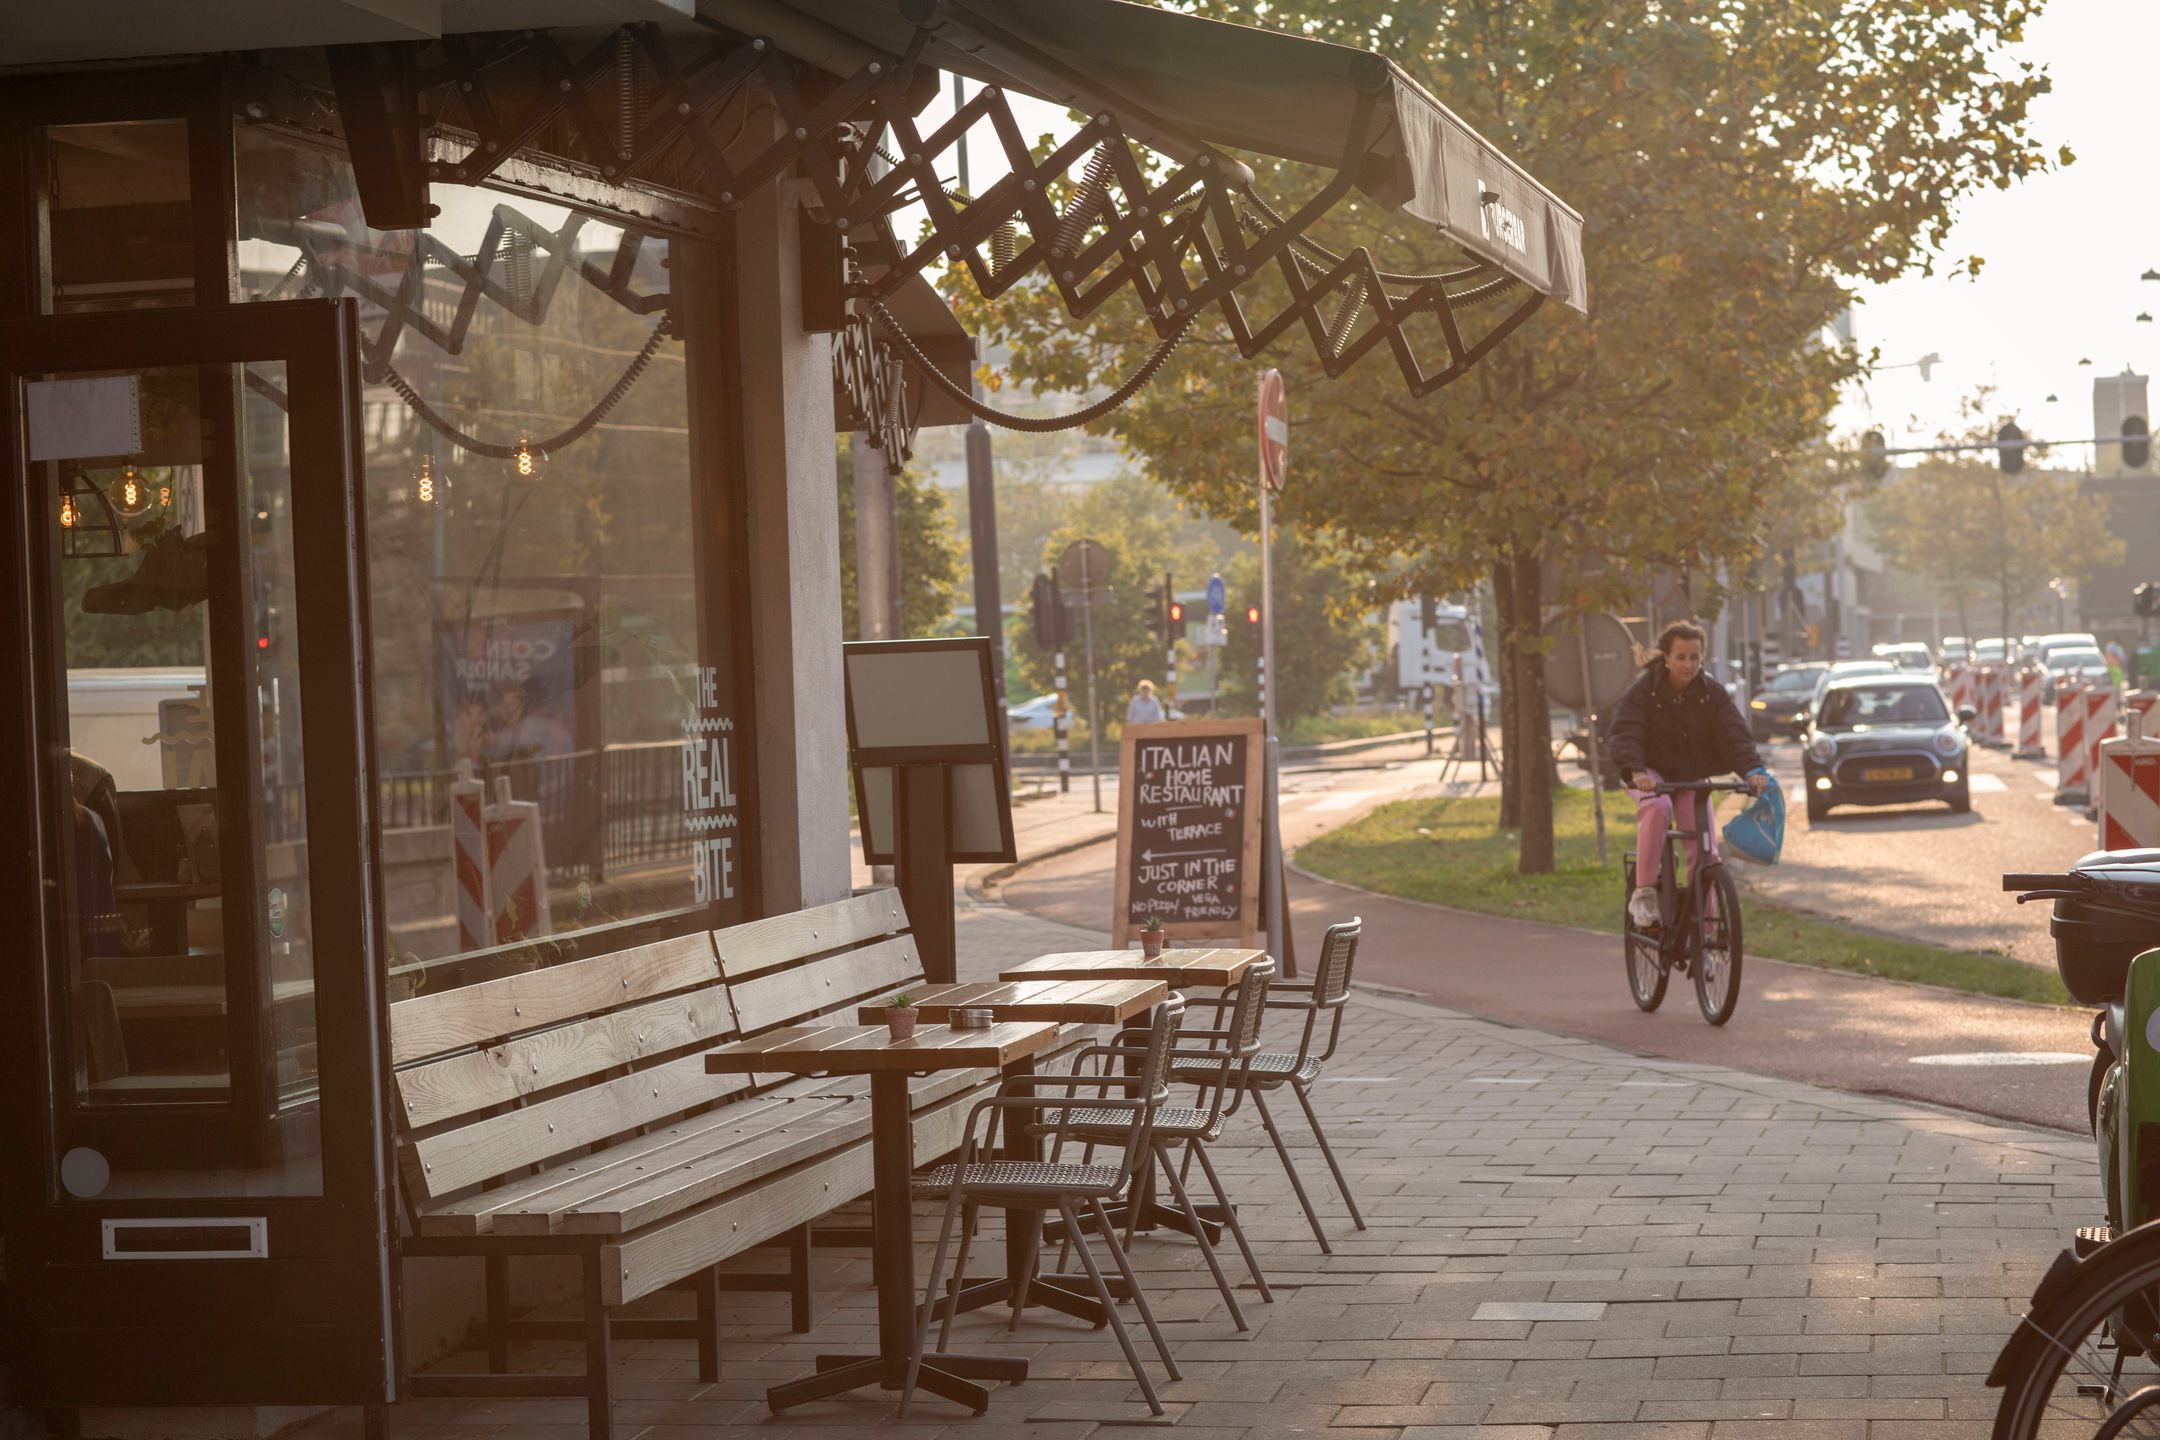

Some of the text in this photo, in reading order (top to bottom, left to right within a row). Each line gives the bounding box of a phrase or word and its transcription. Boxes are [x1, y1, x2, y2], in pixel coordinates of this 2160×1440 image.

[694, 667, 718, 708] THE
[1141, 742, 1234, 773] ITALIAN
[681, 737, 737, 811] REAL
[1166, 768, 1213, 787] HOME
[1139, 784, 1244, 807] RESTAURANT
[1167, 822, 1223, 841] TERRACE
[692, 837, 734, 903] BITE
[1138, 858, 1237, 884] JUST IN THE
[1157, 876, 1218, 894] CORNER
[1132, 901, 1146, 914] NO
[1191, 892, 1221, 904] VEGA
